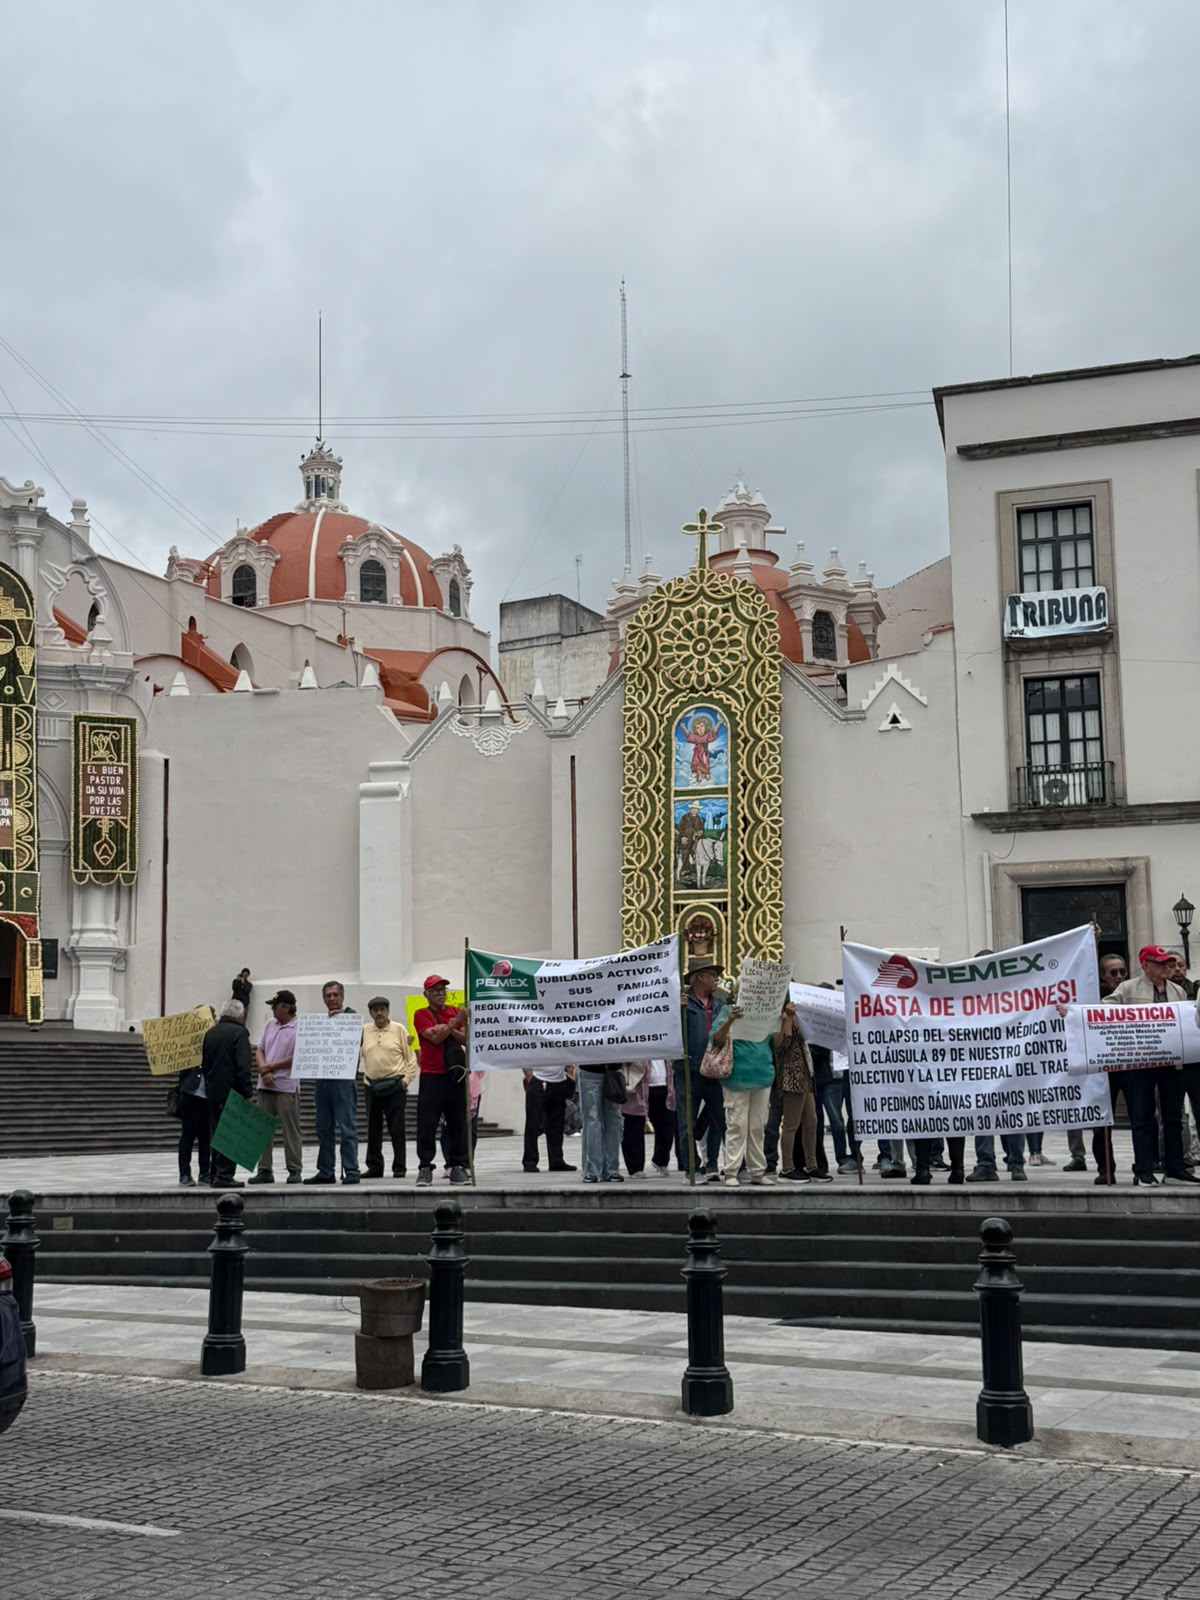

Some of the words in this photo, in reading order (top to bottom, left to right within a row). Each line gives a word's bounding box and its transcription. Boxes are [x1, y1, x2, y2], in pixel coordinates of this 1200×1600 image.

[1008, 592, 1106, 627] TRIBUNA
[87, 765, 97, 774] EL
[102, 766, 124, 775] BUEN
[90, 776, 121, 784] PASTOR
[86, 786, 95, 794] DA
[98, 786, 107, 795] SU
[109, 786, 125, 795] VIDA
[90, 796, 105, 804] POR
[108, 797, 122, 806] LAS
[90, 806, 121, 816] OVEJAS
[537, 972, 604, 984] JUBILADOS
[607, 966, 662, 978] ACTIVOS,
[925, 953, 1044, 984] PEMEX
[476, 978, 528, 988] PEMEX
[568, 986, 592, 996] SUS
[617, 977, 669, 991] FAMILIAS
[475, 1003, 544, 1011] REQUERIMOS
[554, 998, 616, 1010] ATENCIÓN
[626, 990, 670, 1004] MÉDICA
[854, 994, 922, 1024] ¡BASTA
[930, 996, 955, 1016] DE
[962, 979, 1077, 1016] OMISIONES!
[508, 1013, 600, 1023] ENFERMEDADES
[611, 1004, 670, 1018] CRÓNICAS
[1086, 1006, 1176, 1022] INJUSTICIA
[475, 1028, 564, 1038] DEGENERATIVAS,
[569, 1024, 618, 1034] CÁNCER,
[852, 1032, 864, 1045] EL
[868, 1028, 919, 1044] COLAPSO
[923, 1028, 944, 1042] DEL
[948, 1026, 1002, 1042] SERVICIO
[1006, 1020, 1047, 1040] MÉDICO
[488, 1042, 537, 1051] ALGUNOS
[540, 1038, 604, 1048] NECESITAN
[854, 1051, 867, 1064] LA
[871, 1046, 928, 1064] CLÁUSULA
[932, 1048, 946, 1062] 89
[950, 1048, 965, 1062] DE
[969, 1044, 1020, 1061] NUESTRO
[908, 1069, 914, 1082] Y
[918, 1068, 934, 1082] LA
[937, 1068, 957, 1082] LEY
[962, 1064, 1012, 1082] FEDERAL
[1016, 1062, 1038, 1077] DEL
[864, 1098, 878, 1112] NO
[881, 1096, 924, 1112] PEDIMOS
[928, 1090, 972, 1110] DÁDIVAS
[975, 1090, 1024, 1108] EXIGIMOS
[1028, 1085, 1082, 1104] NUESTROS
[902, 1117, 950, 1134] GANADOS
[952, 1116, 975, 1132] CON
[978, 1115, 991, 1130] 30
[995, 1110, 1024, 1130] AÑOS
[1026, 1112, 1040, 1127] DE
[1042, 1106, 1104, 1126] ESFUERZOS.
